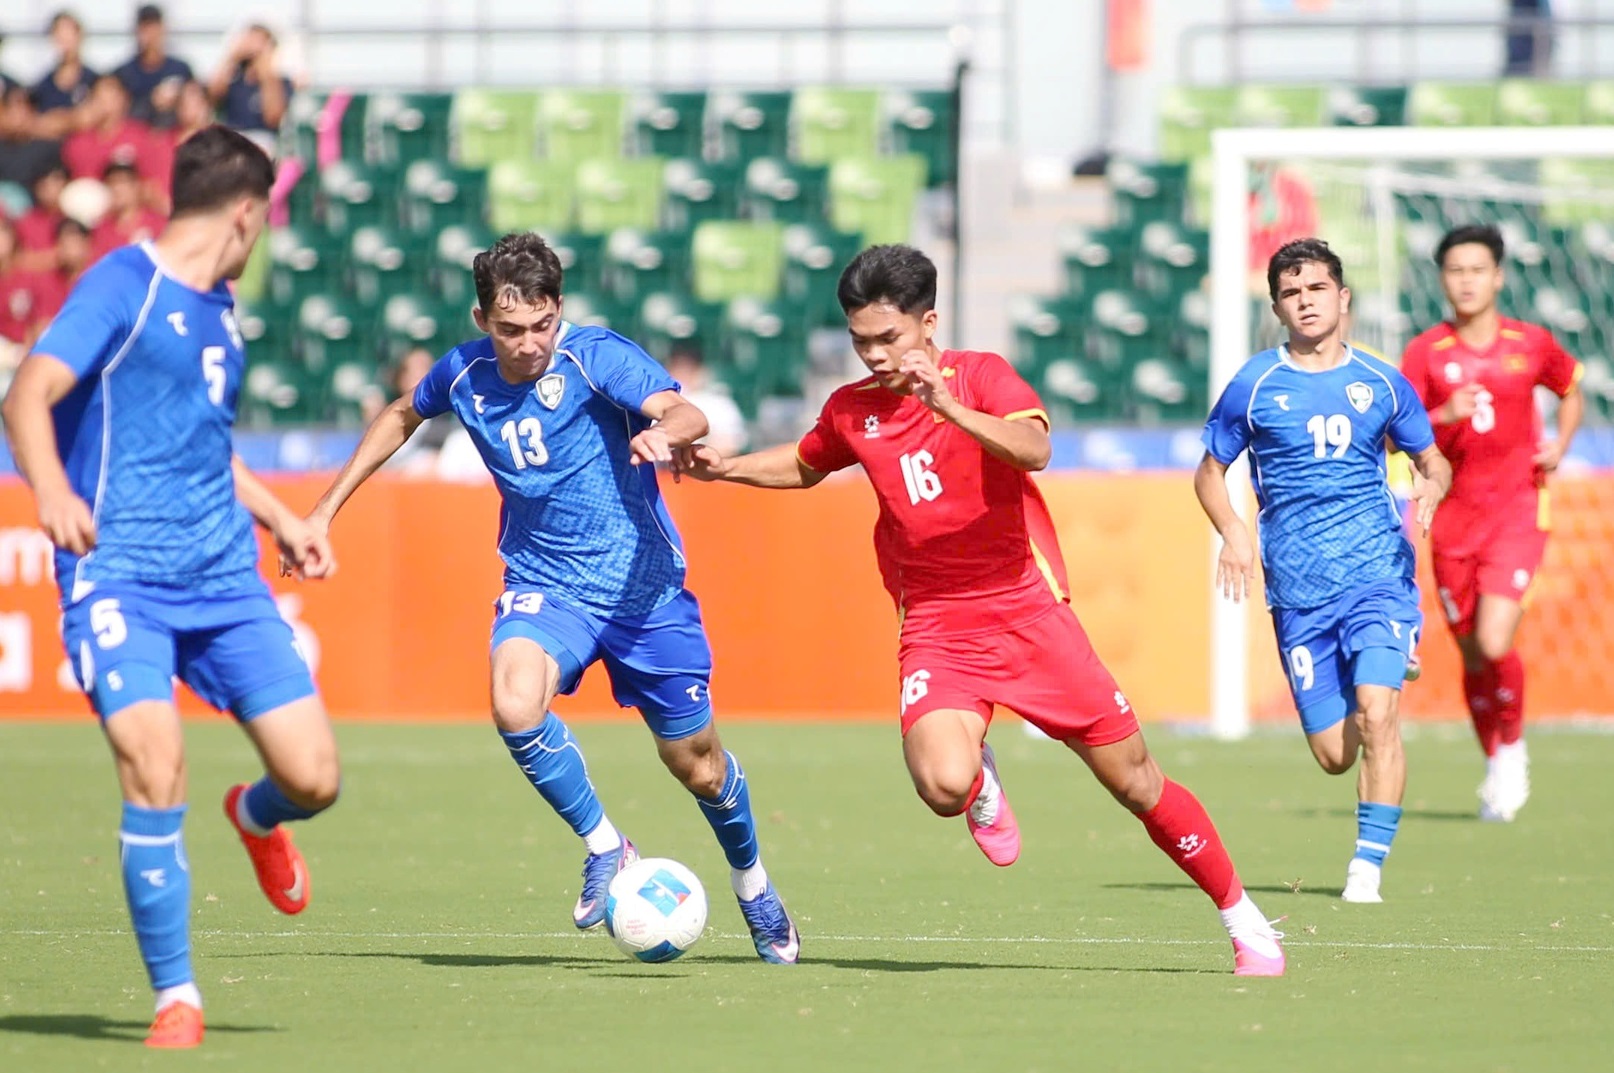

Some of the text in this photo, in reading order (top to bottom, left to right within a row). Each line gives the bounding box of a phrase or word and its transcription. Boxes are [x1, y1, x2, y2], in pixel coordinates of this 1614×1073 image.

[201, 346, 227, 406] 5
[500, 417, 549, 470] 13
[1306, 413, 1352, 459] 19
[899, 449, 944, 506] 16
[89, 598, 128, 650] 5
[499, 591, 544, 619] 13
